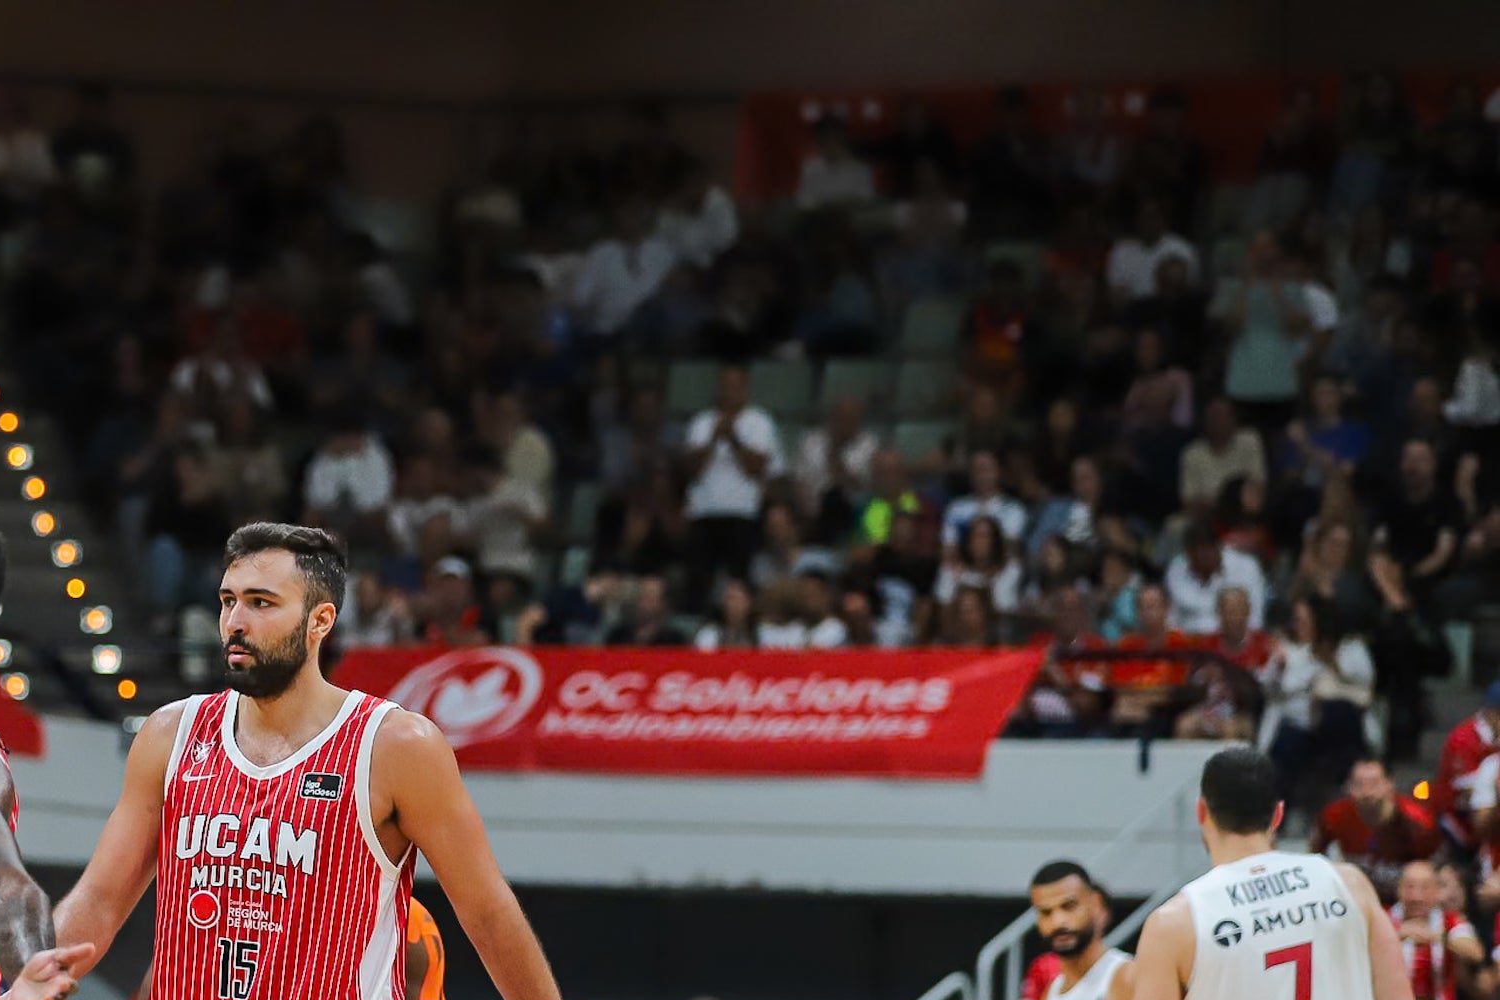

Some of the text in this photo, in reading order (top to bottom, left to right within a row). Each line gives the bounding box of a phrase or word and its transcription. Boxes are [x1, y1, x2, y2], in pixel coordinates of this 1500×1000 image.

[650, 671, 950, 713] Soluciones
[176, 813, 317, 875] UCAM
[190, 865, 287, 899] MURCIA
[1226, 866, 1310, 906] KURUCS
[228, 907, 269, 920] REGIÓN
[228, 917, 283, 933] DE MURCIA
[1252, 900, 1348, 937] AMUTIO
[218, 938, 260, 1000] 15
